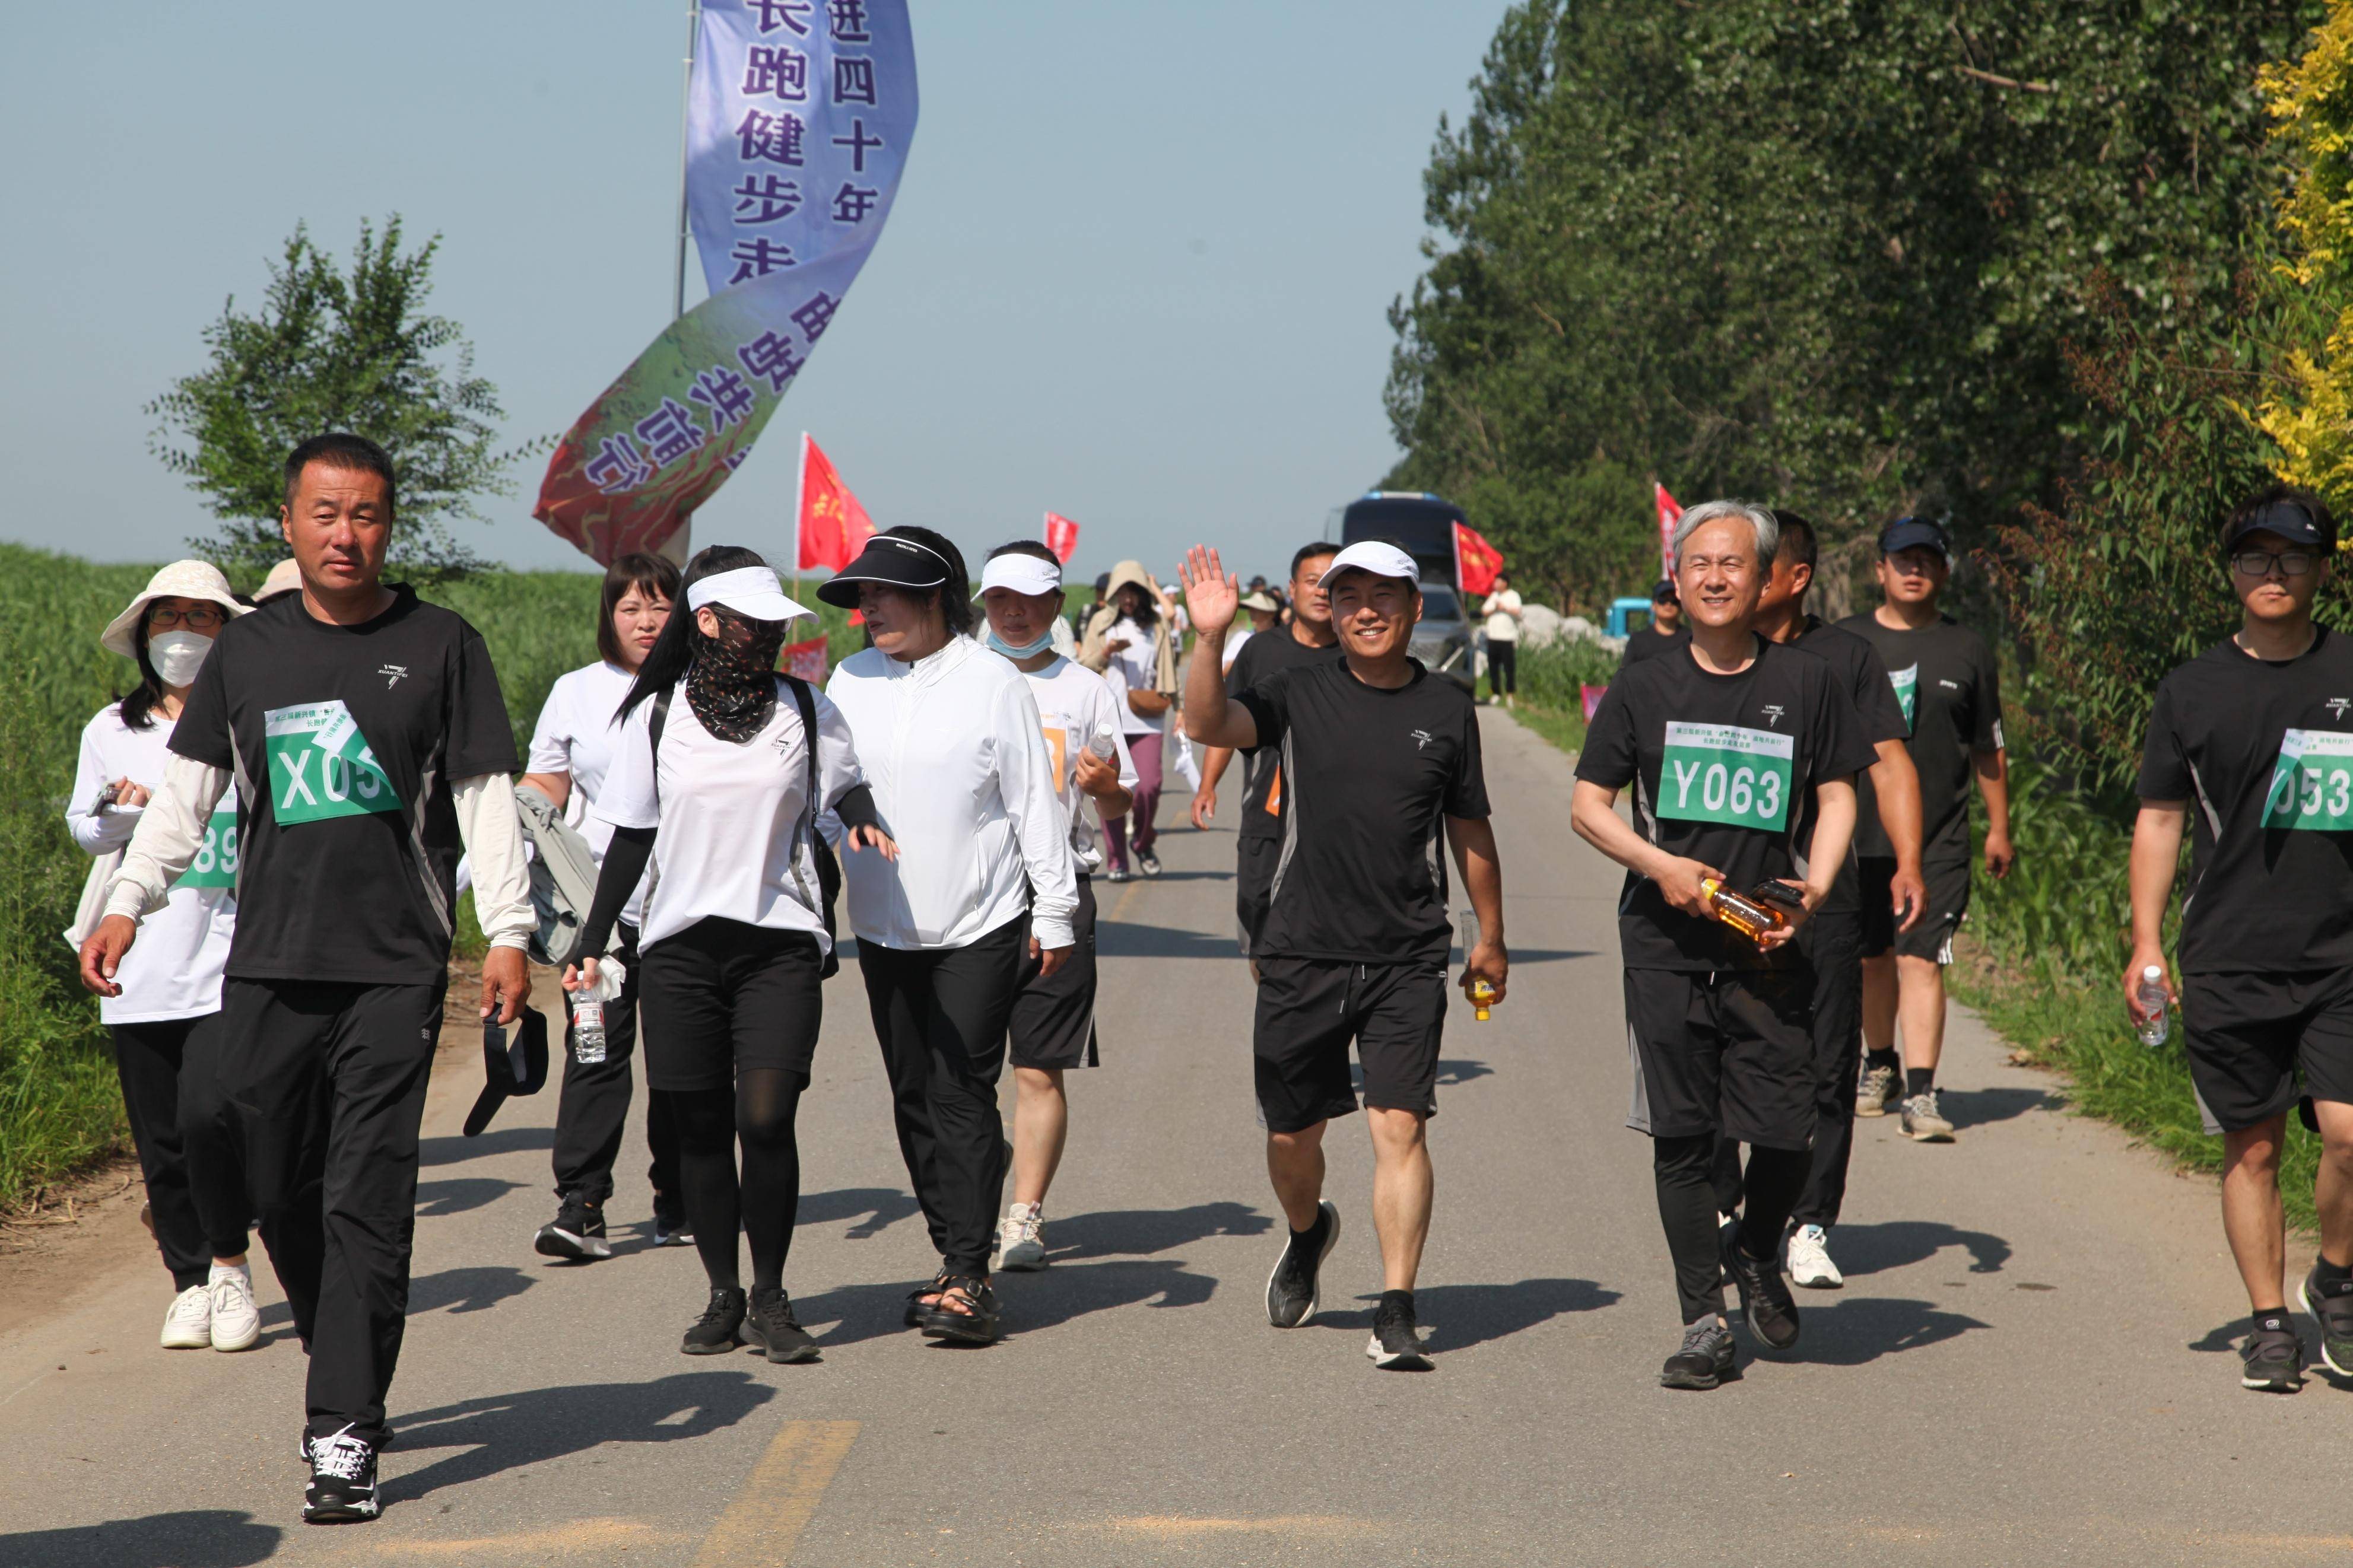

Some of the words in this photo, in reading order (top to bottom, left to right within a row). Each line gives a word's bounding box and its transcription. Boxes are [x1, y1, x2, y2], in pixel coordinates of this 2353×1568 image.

[827, 0, 882, 225] 进四十年
[277, 749, 396, 809] X05
[1673, 759, 1781, 819] Y063
